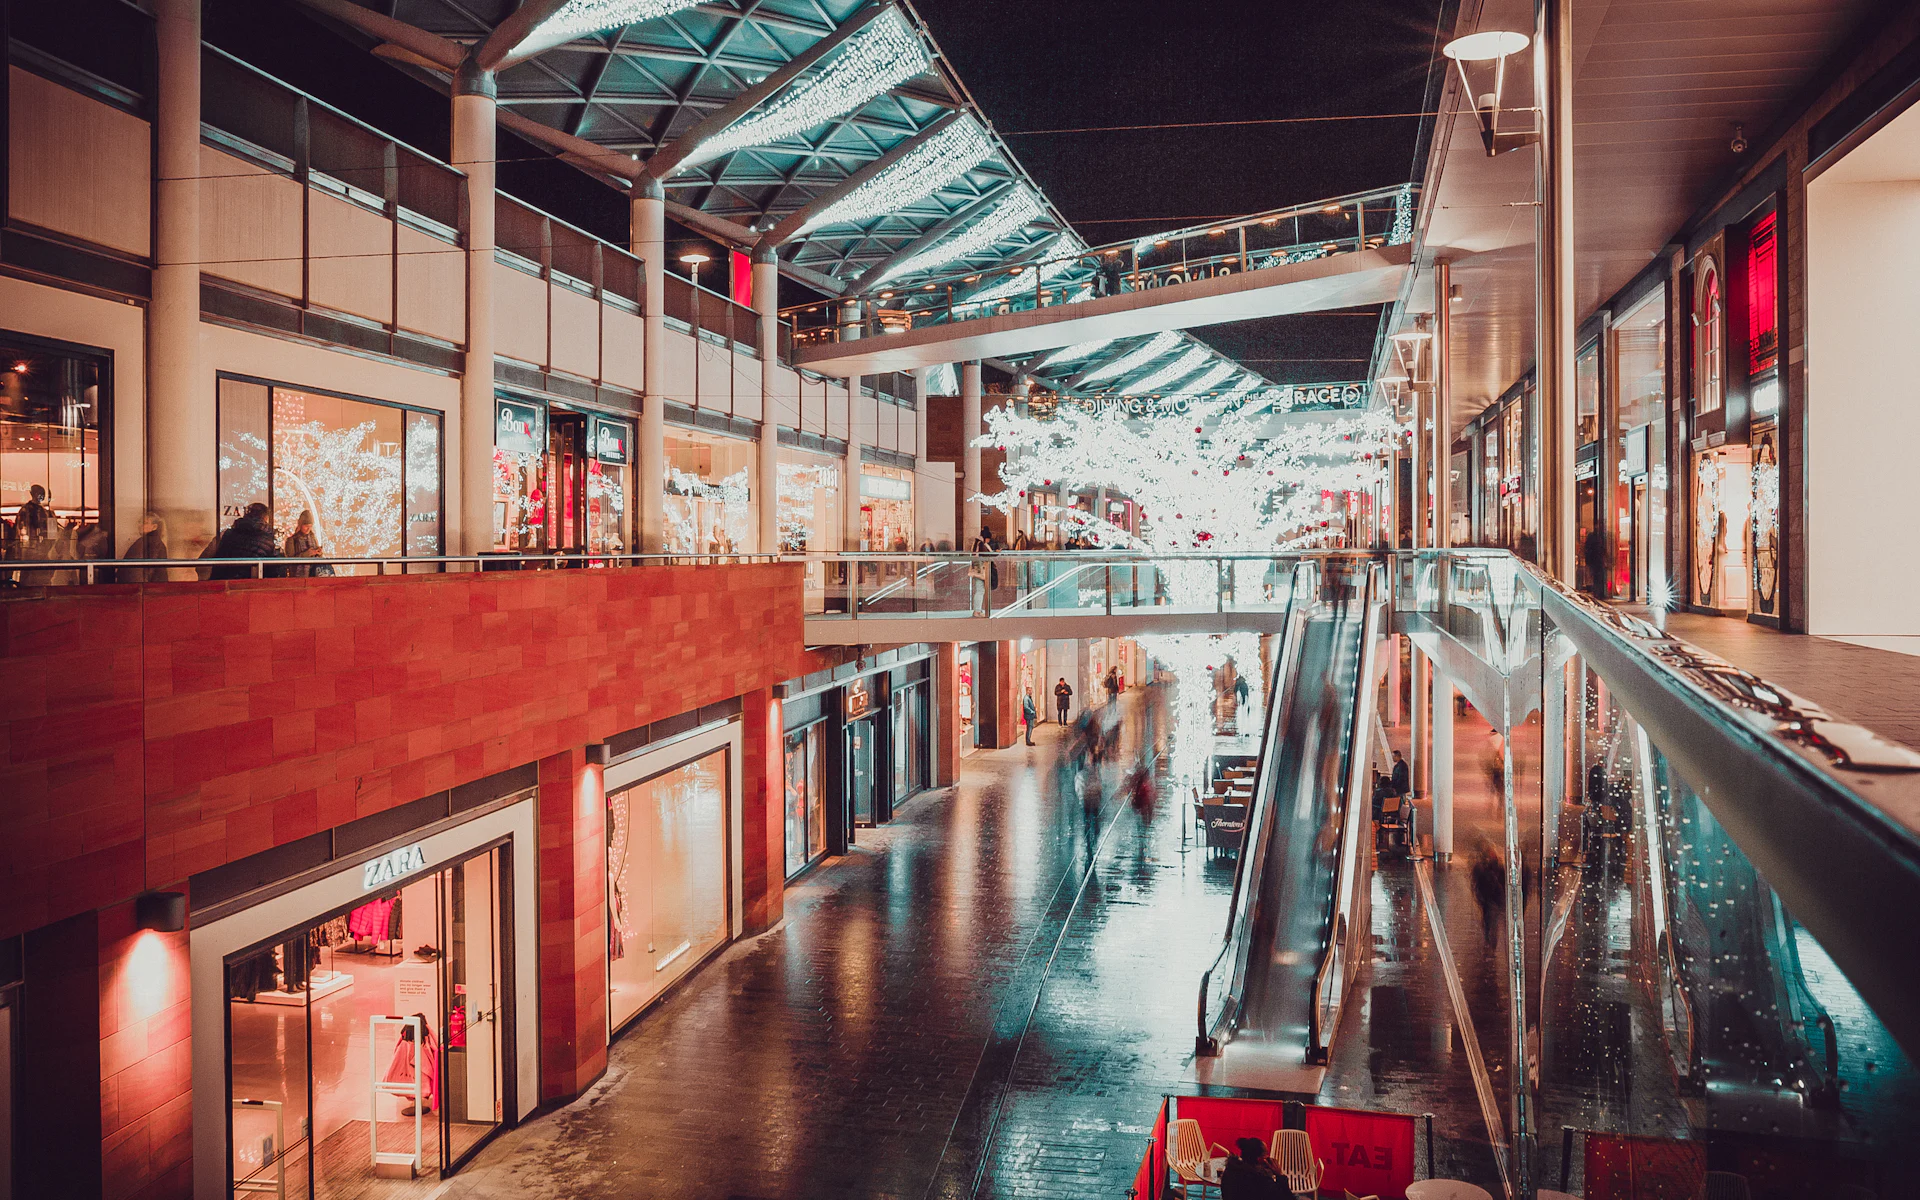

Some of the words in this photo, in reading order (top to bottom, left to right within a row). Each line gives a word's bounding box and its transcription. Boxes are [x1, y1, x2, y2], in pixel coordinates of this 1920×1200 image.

[1146, 398, 1156, 412] &
[501, 407, 532, 439] Boux
[600, 426, 625, 454] Boux
[224, 505, 249, 517] ZA
[364, 845, 426, 888] ZARA
